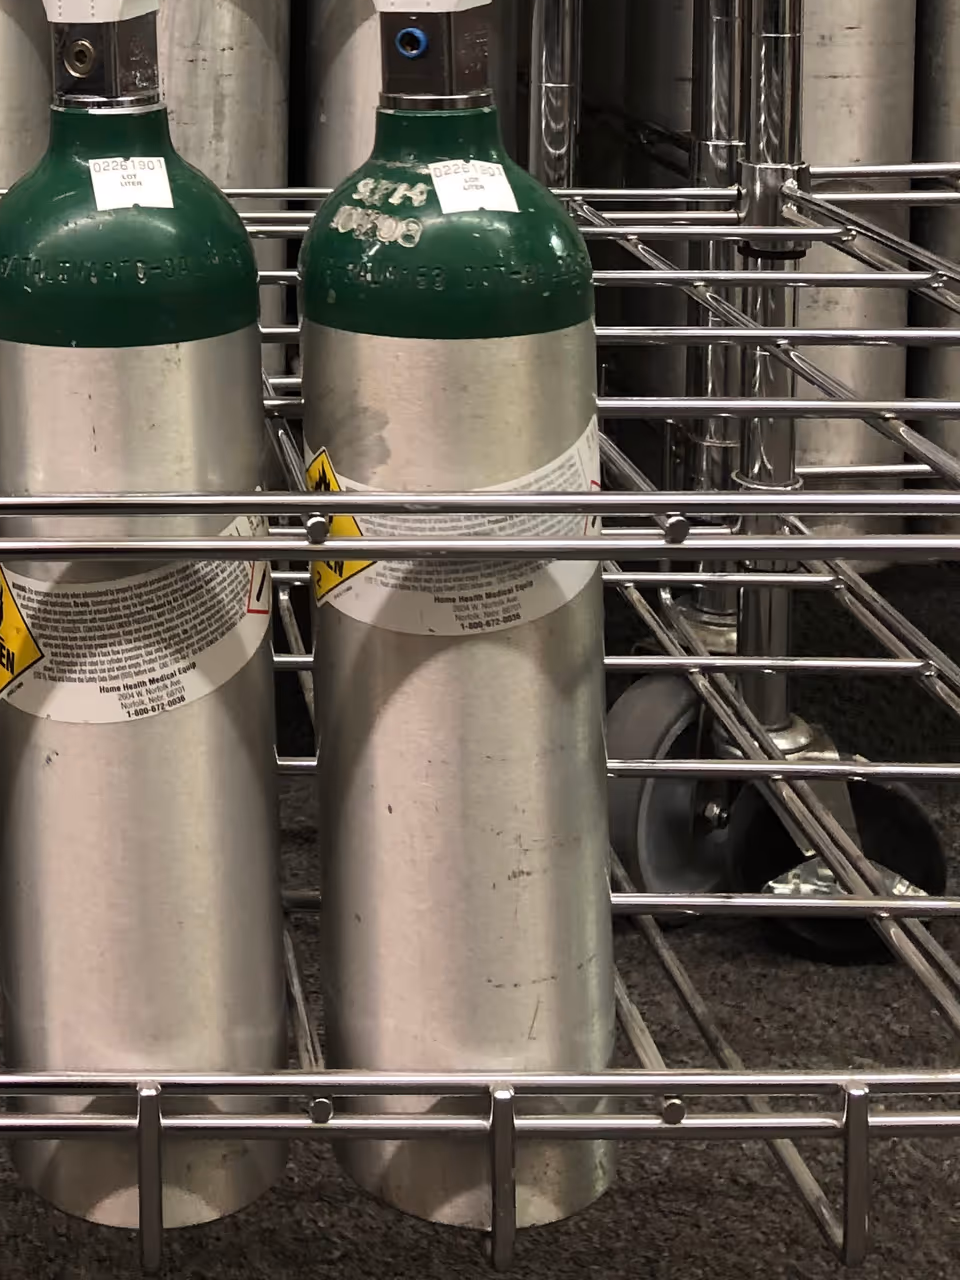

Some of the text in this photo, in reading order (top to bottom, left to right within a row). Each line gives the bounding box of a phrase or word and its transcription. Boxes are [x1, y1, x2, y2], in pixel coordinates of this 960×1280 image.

[93, 159, 164, 174] 02261901
[434, 594, 456, 604] Home
[458, 593, 484, 603] Health
[485, 586, 514, 599] Medical
[99, 661, 197, 694] Home Health Medical Equip
[145, 684, 169, 697] Norfolk
